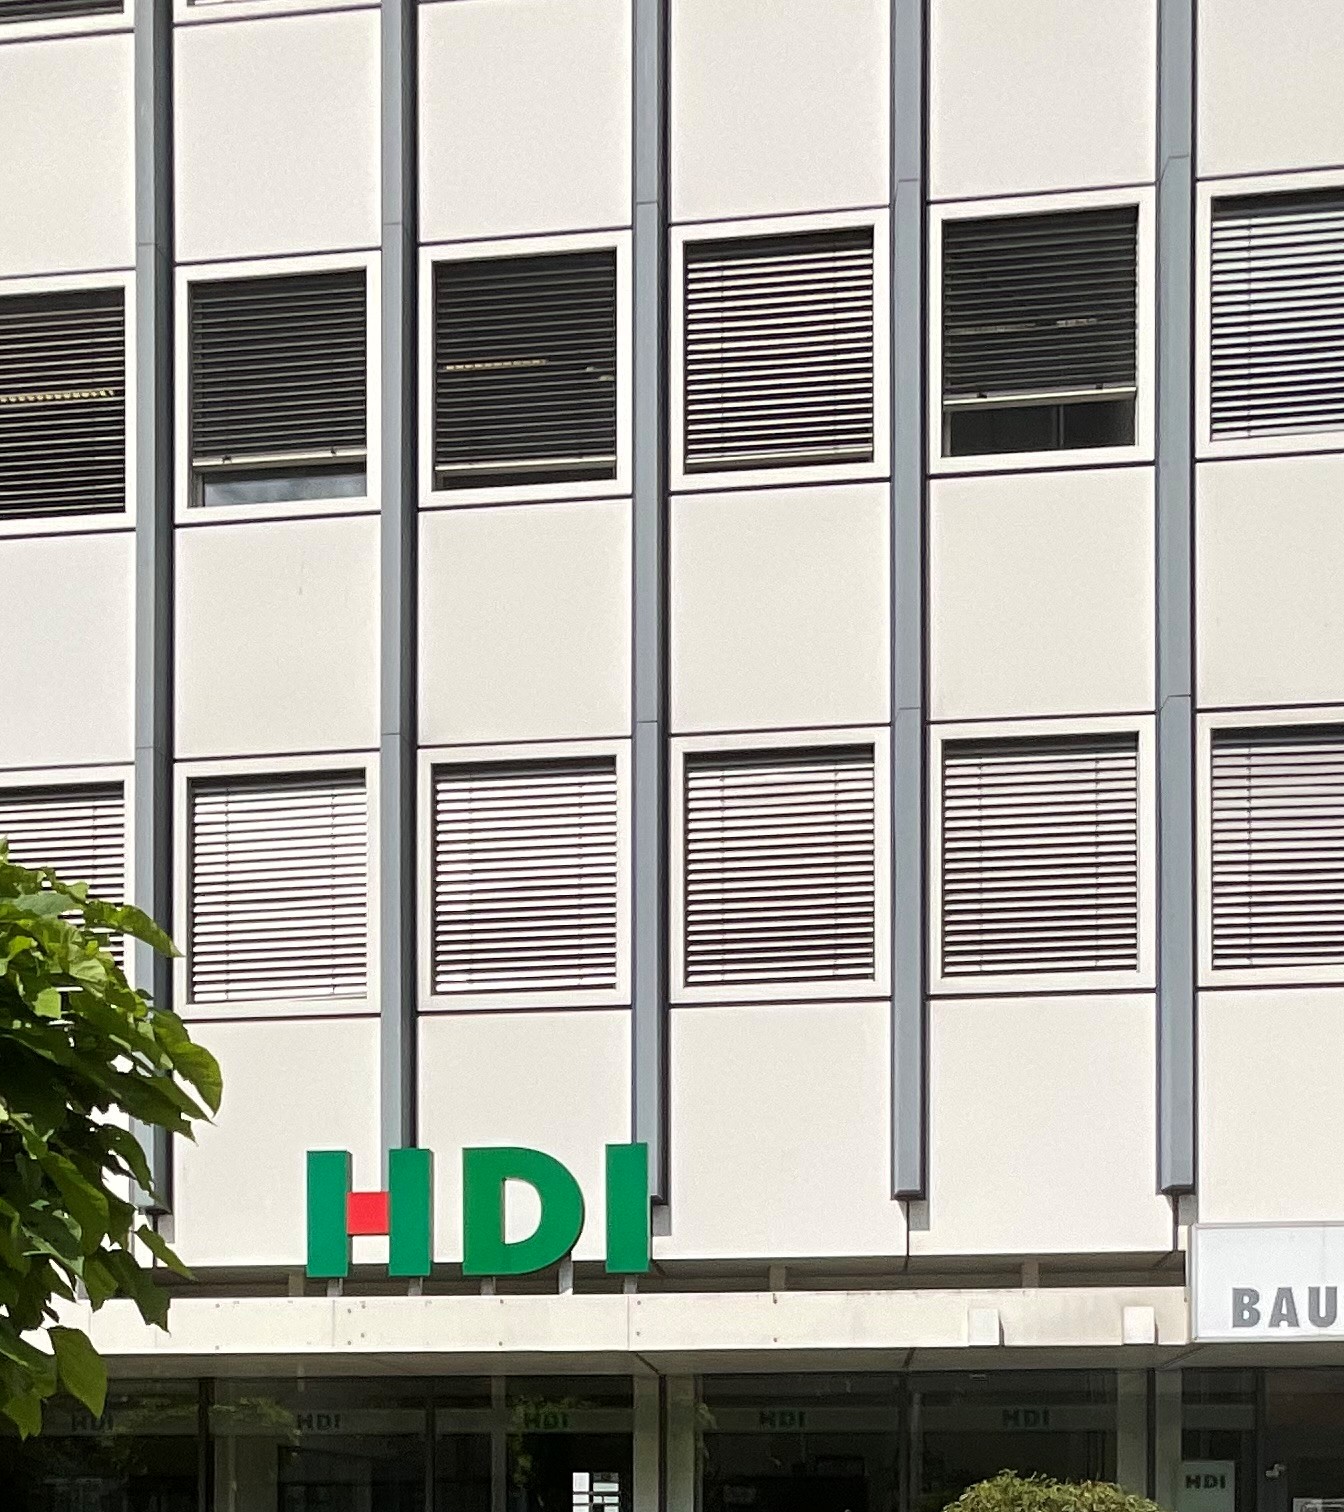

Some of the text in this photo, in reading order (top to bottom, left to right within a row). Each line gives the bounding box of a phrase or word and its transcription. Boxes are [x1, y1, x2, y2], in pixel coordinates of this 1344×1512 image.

[307, 1143, 649, 1278] HDI
[297, 1413, 341, 1430] HDI
[524, 1411, 569, 1429] HDI
[759, 1410, 805, 1427] HDI
[1002, 1408, 1050, 1427] HDI
[1185, 1474, 1227, 1489] HDI
